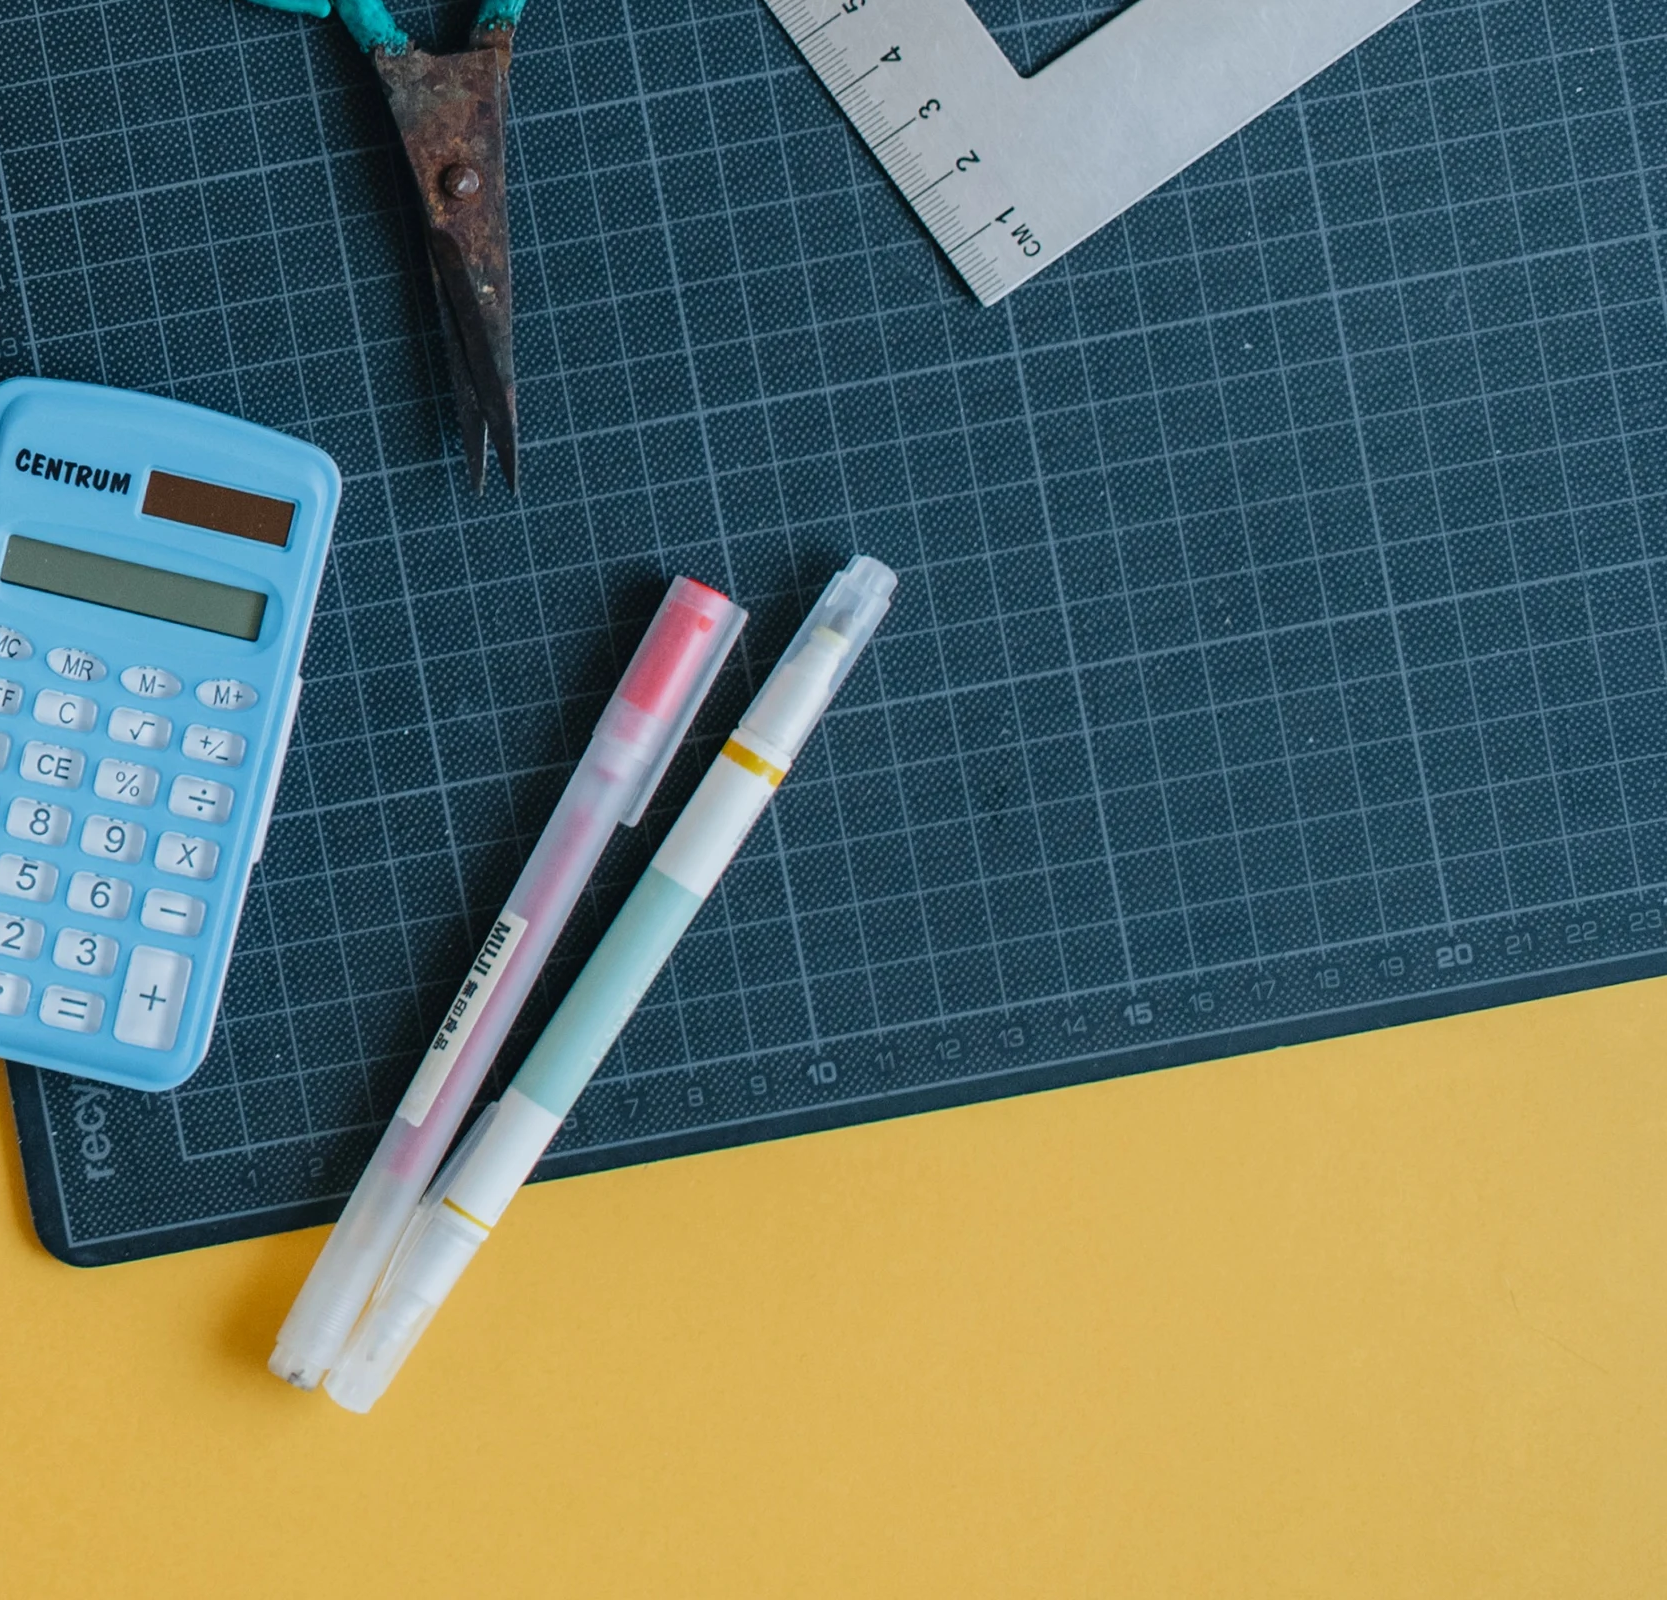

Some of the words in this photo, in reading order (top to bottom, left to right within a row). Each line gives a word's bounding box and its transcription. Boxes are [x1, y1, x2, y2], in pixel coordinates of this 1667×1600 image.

[879, 46, 902, 63] 4
[918, 98, 941, 119] 3
[956, 149, 981, 172] 2
[994, 205, 1015, 224] 1
[1010, 223, 1041, 257] CM
[14, 448, 132, 495] CENTRUM
[63, 654, 94, 680] MR
[58, 701, 75, 724] C
[36, 754, 72, 781] CE
[29, 808, 51, 835] 8
[105, 825, 126, 853] 9
[14, 865, 38, 892] 5
[90, 882, 112, 908] 6
[1567, 920, 1598, 943] 22
[1629, 909, 1662, 932] 23
[1, 922, 25, 949] 2
[1505, 932, 1533, 955] 21
[75, 938, 97, 965] 3
[472, 922, 512, 975] MUJI
[1436, 944, 1473, 970] 20
[1378, 956, 1405, 978] 19
[1251, 980, 1276, 1001] 17
[1314, 969, 1340, 990] 18
[1189, 991, 1215, 1013] 16
[1061, 1016, 1088, 1037] 14
[1123, 1004, 1153, 1027] 15
[935, 1039, 962, 1060] 12
[997, 1027, 1024, 1049] 13
[874, 1051, 896, 1072] 11
[750, 1074, 767, 1095] 9
[806, 1061, 837, 1086] 10
[623, 1098, 639, 1119] 7
[687, 1087, 704, 1107] 8
